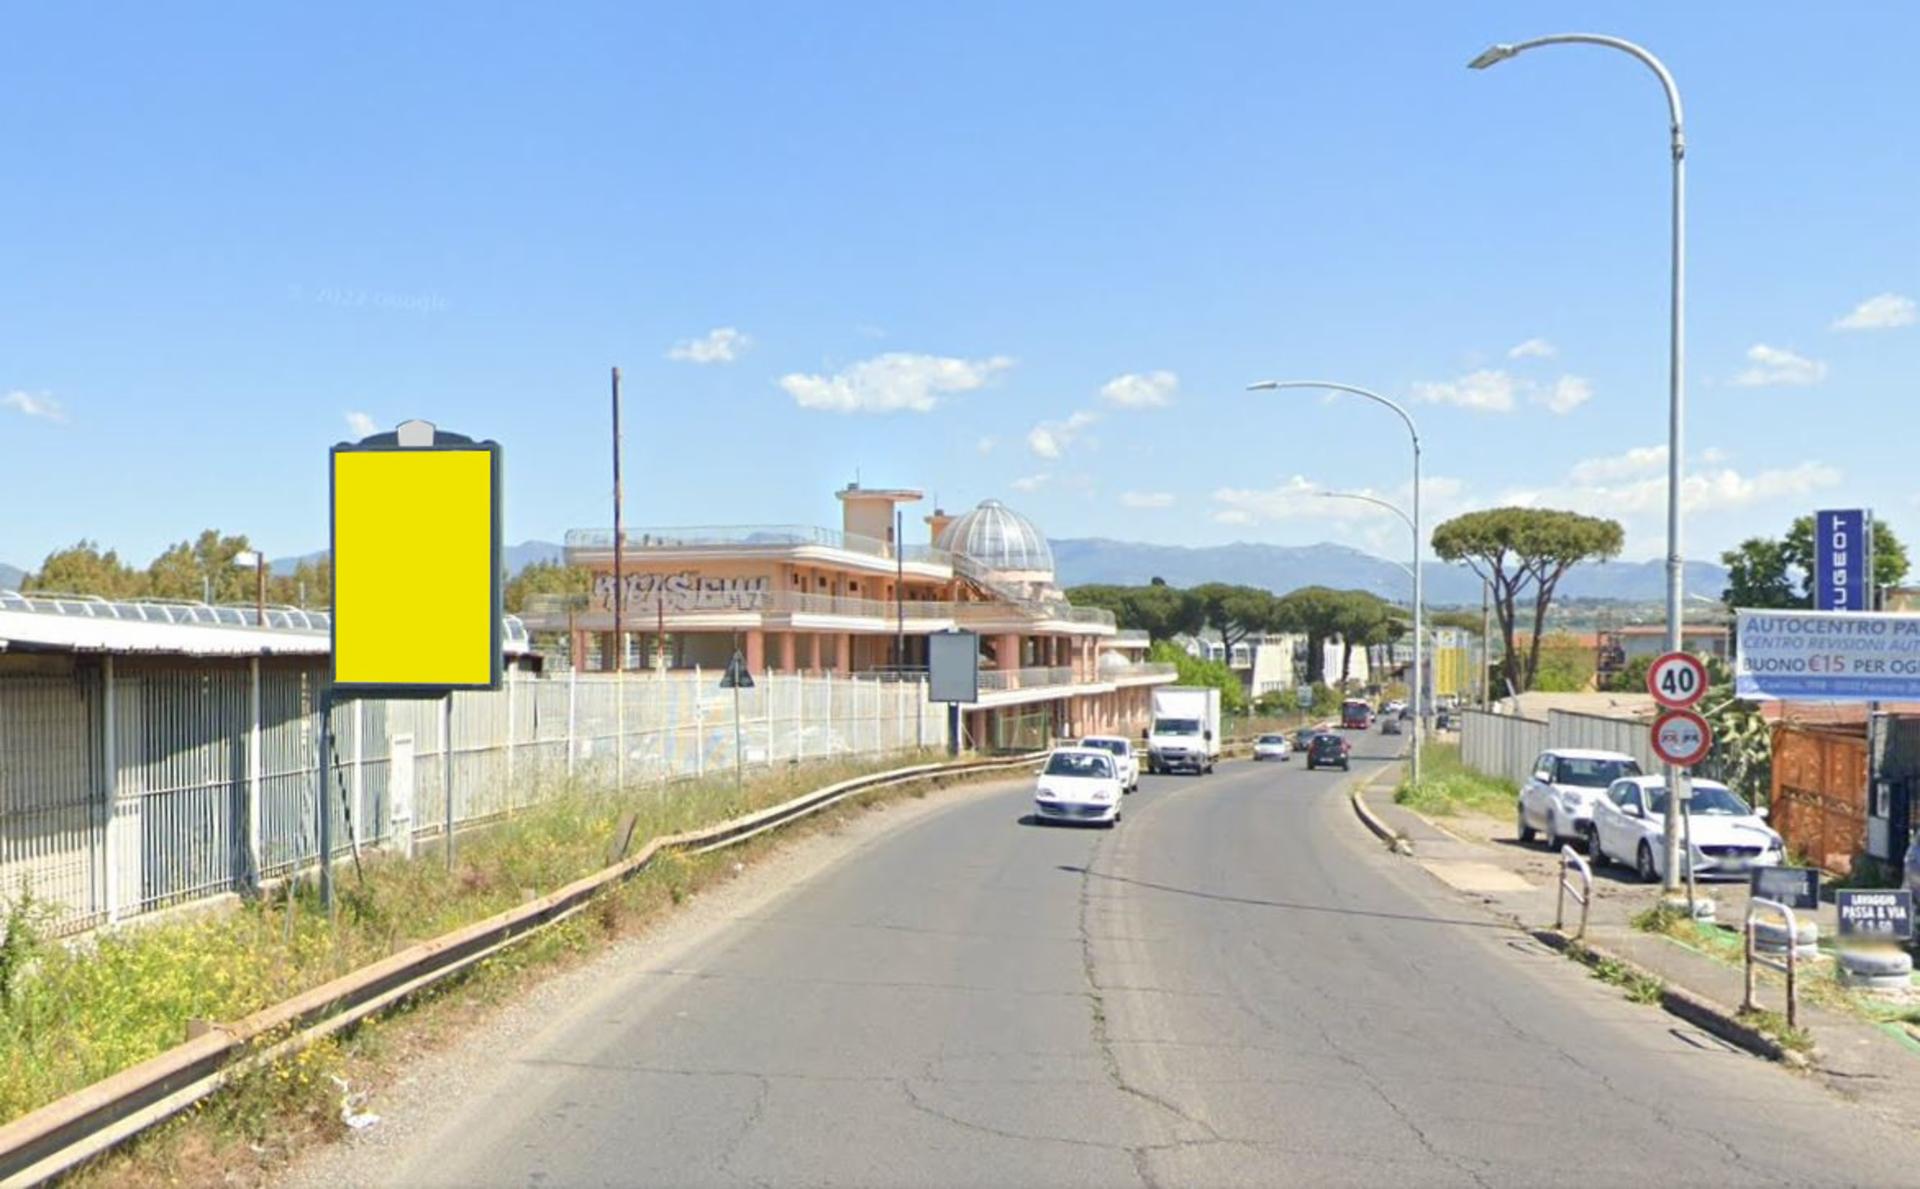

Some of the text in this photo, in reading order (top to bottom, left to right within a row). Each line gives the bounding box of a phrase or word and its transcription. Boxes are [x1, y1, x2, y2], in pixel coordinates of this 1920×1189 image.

[1745, 617, 1886, 636] AUTOCENTRO
[1743, 635, 1804, 650] CENTRO
[1743, 654, 1920, 675] BUONO €15 PER OG
[1661, 666, 1694, 694] 40
[1842, 906, 1875, 919] PASSA
[1887, 906, 1907, 919] VIA
